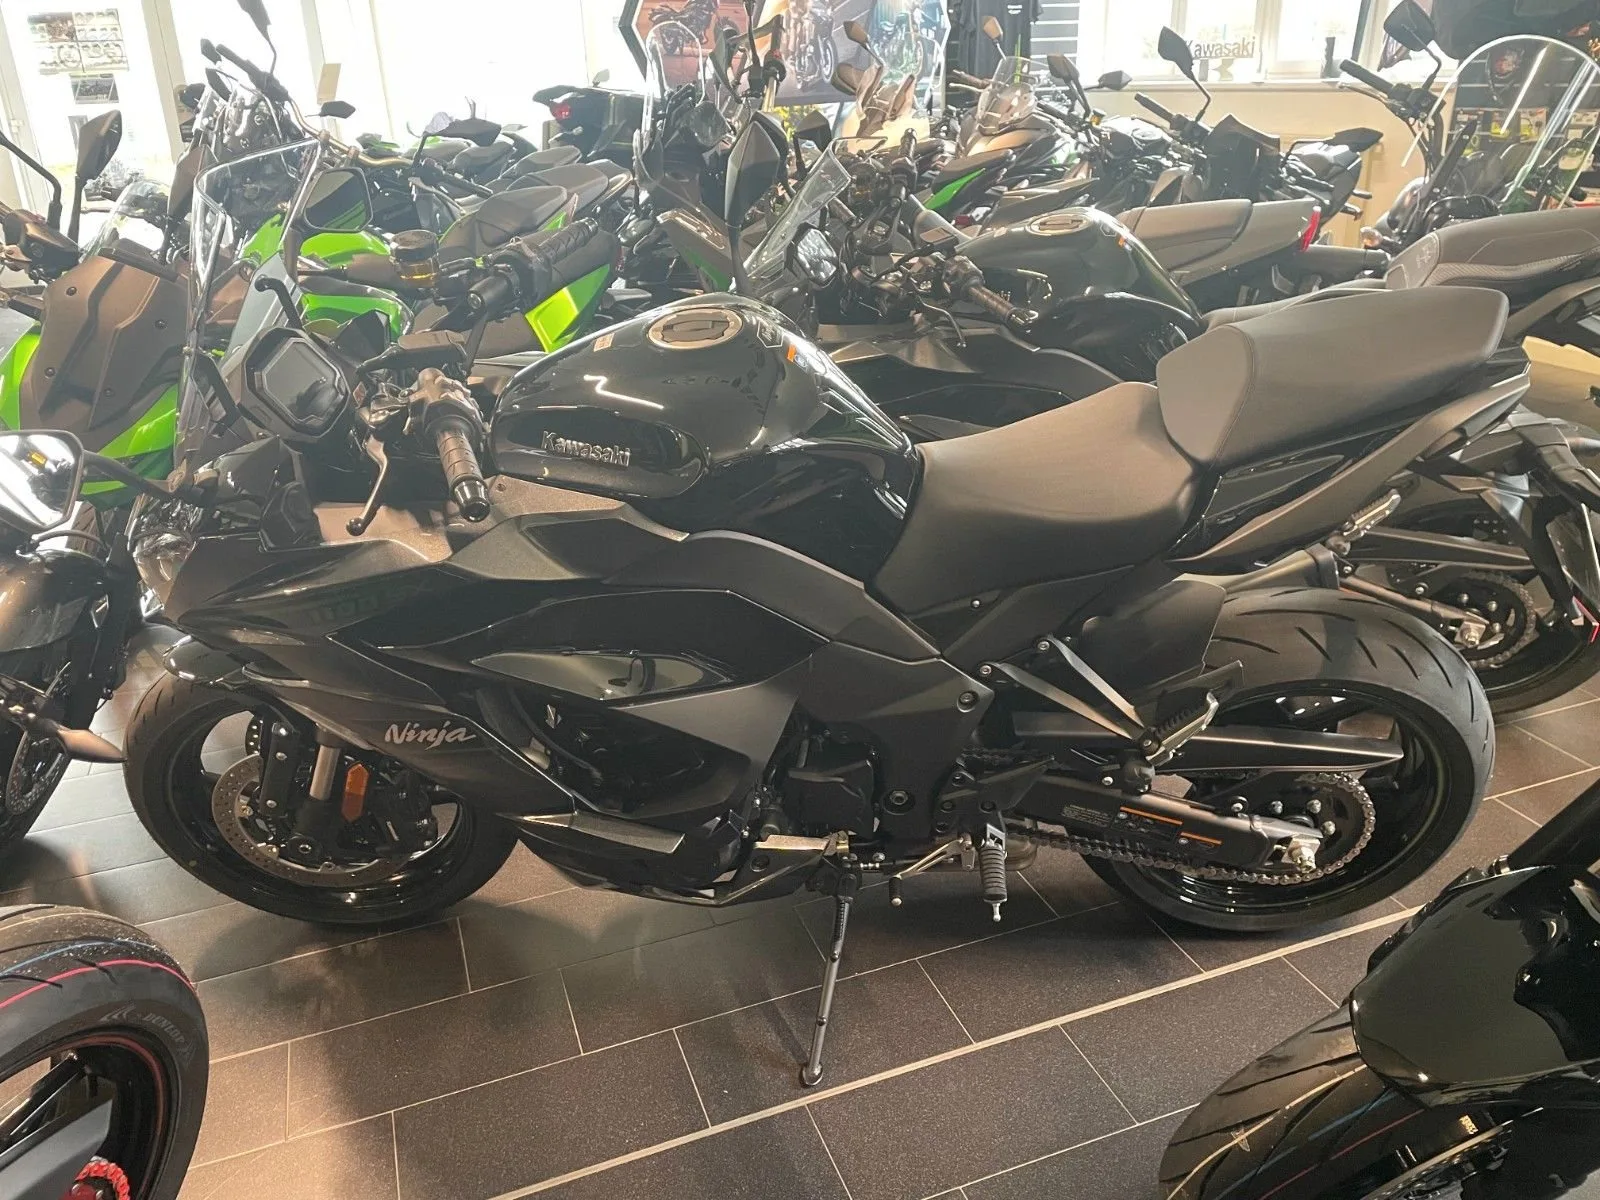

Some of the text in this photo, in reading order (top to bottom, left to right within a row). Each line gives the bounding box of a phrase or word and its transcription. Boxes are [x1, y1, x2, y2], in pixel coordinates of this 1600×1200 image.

[541, 430, 631, 467] Kawasaki
[384, 720, 477, 751] Ninja
[142, 1012, 185, 1043] DUNLOP
